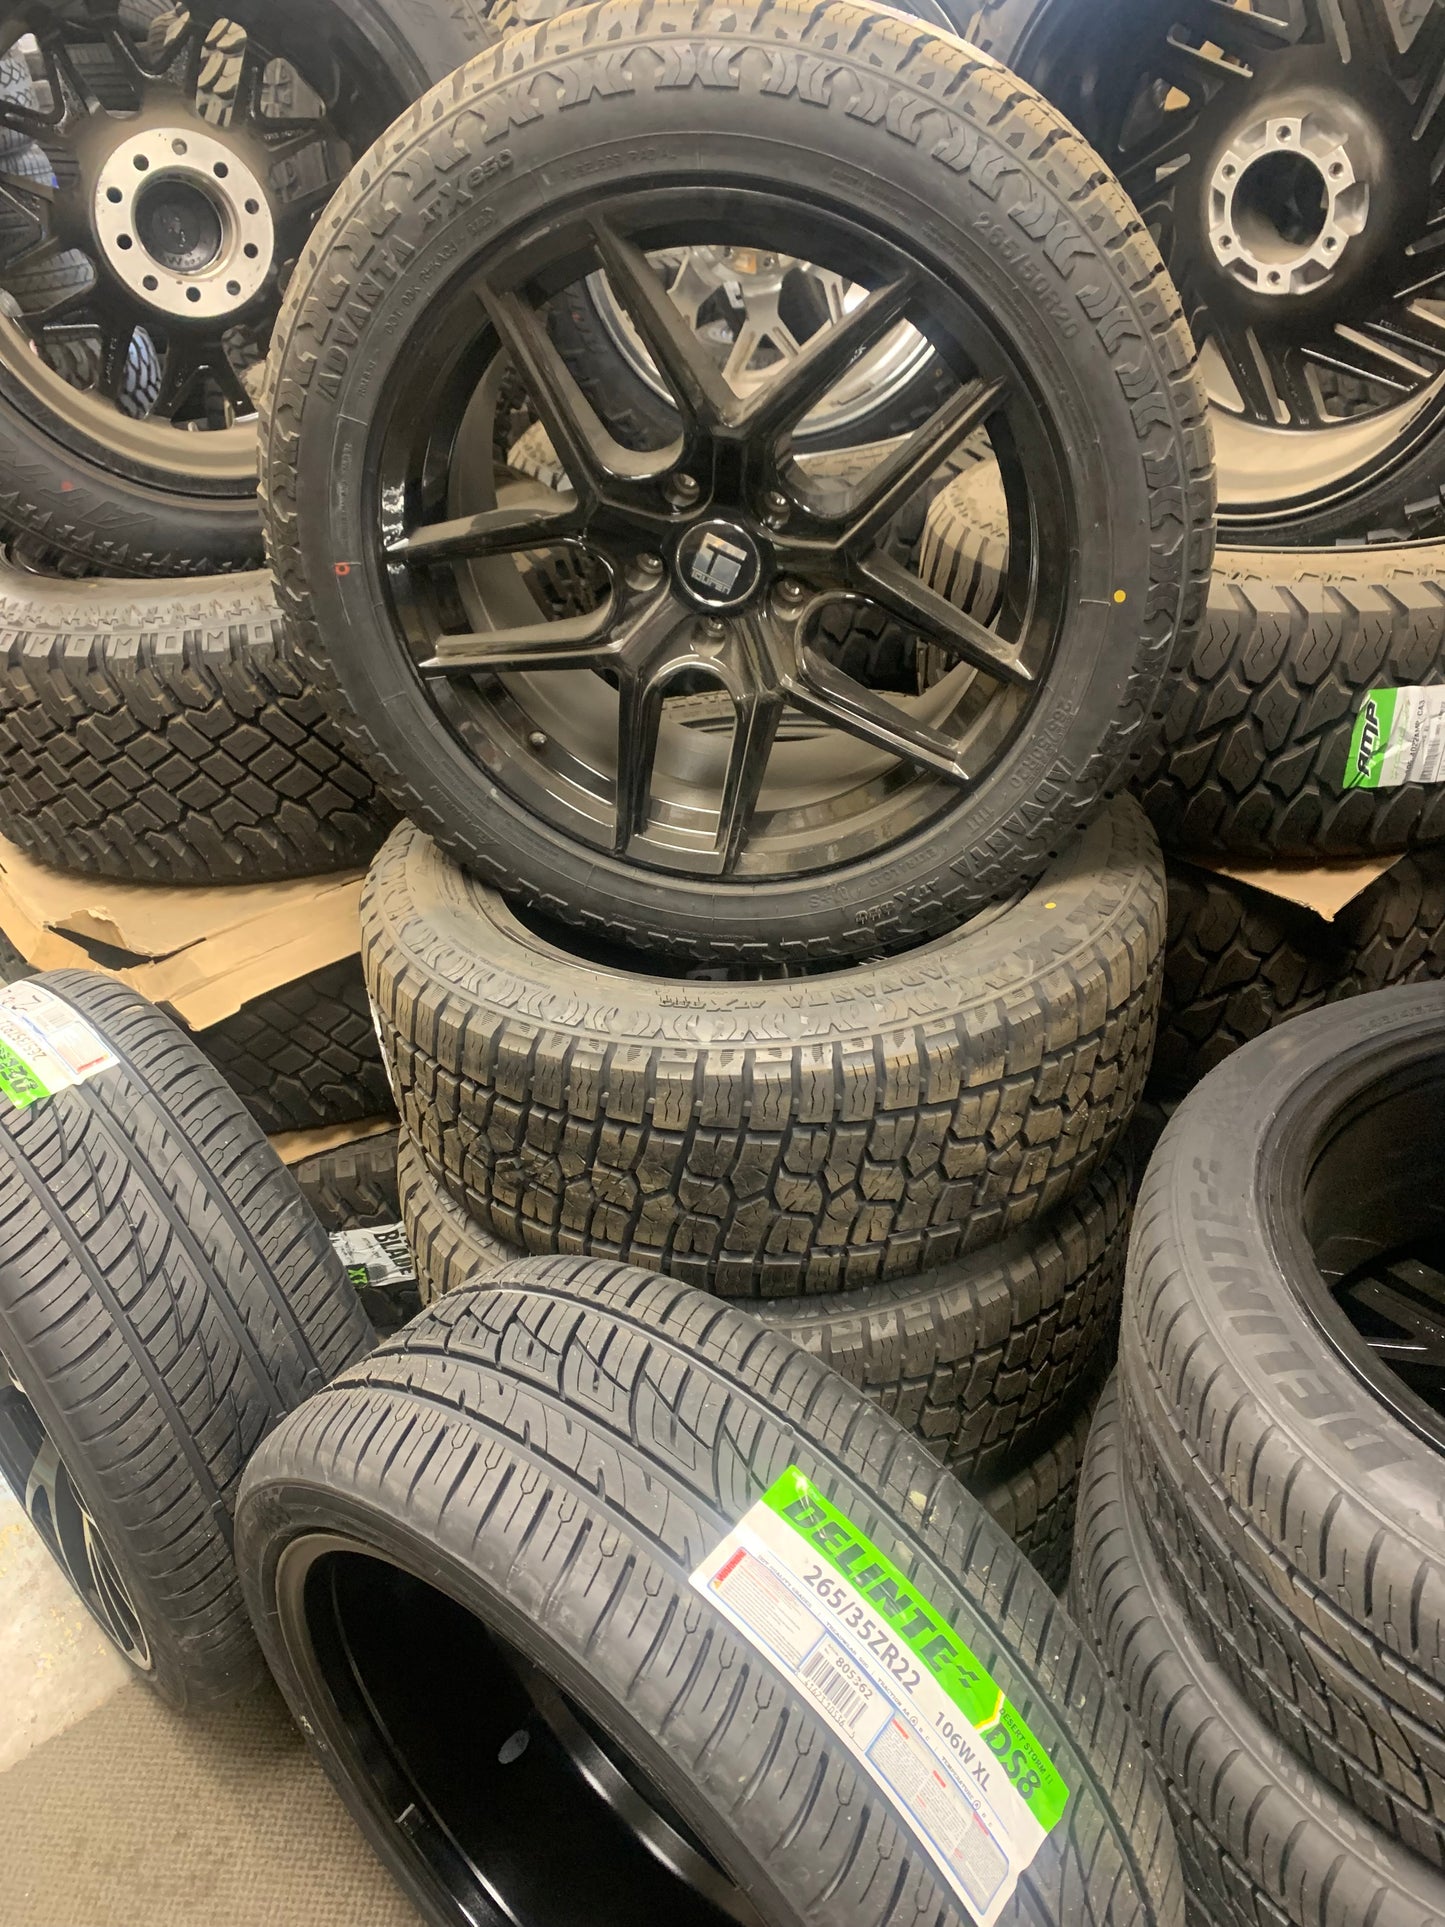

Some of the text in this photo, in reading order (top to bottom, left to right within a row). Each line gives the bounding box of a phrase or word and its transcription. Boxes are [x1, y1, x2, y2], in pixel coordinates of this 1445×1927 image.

[316, 234, 416, 401] ADVANTA
[972, 211, 1079, 339] 265/50R20
[950, 756, 1076, 879] ADVANTA
[1190, 1192, 1412, 1472] DELINTE
[783, 1495, 959, 1672] DELINTE
[803, 1565, 921, 1694] 265/35ZR22
[935, 1712, 976, 1764] 106W
[972, 1761, 991, 1793] XL
[836, 1657, 873, 1700] 805362
[878, 1678, 902, 1706] TRACTION
[941, 1756, 974, 1800] TEMPERATURE
[999, 1708, 1025, 1741] DESERT
[1024, 1742, 1046, 1773] STORM
[986, 1722, 1041, 1800] DS8
